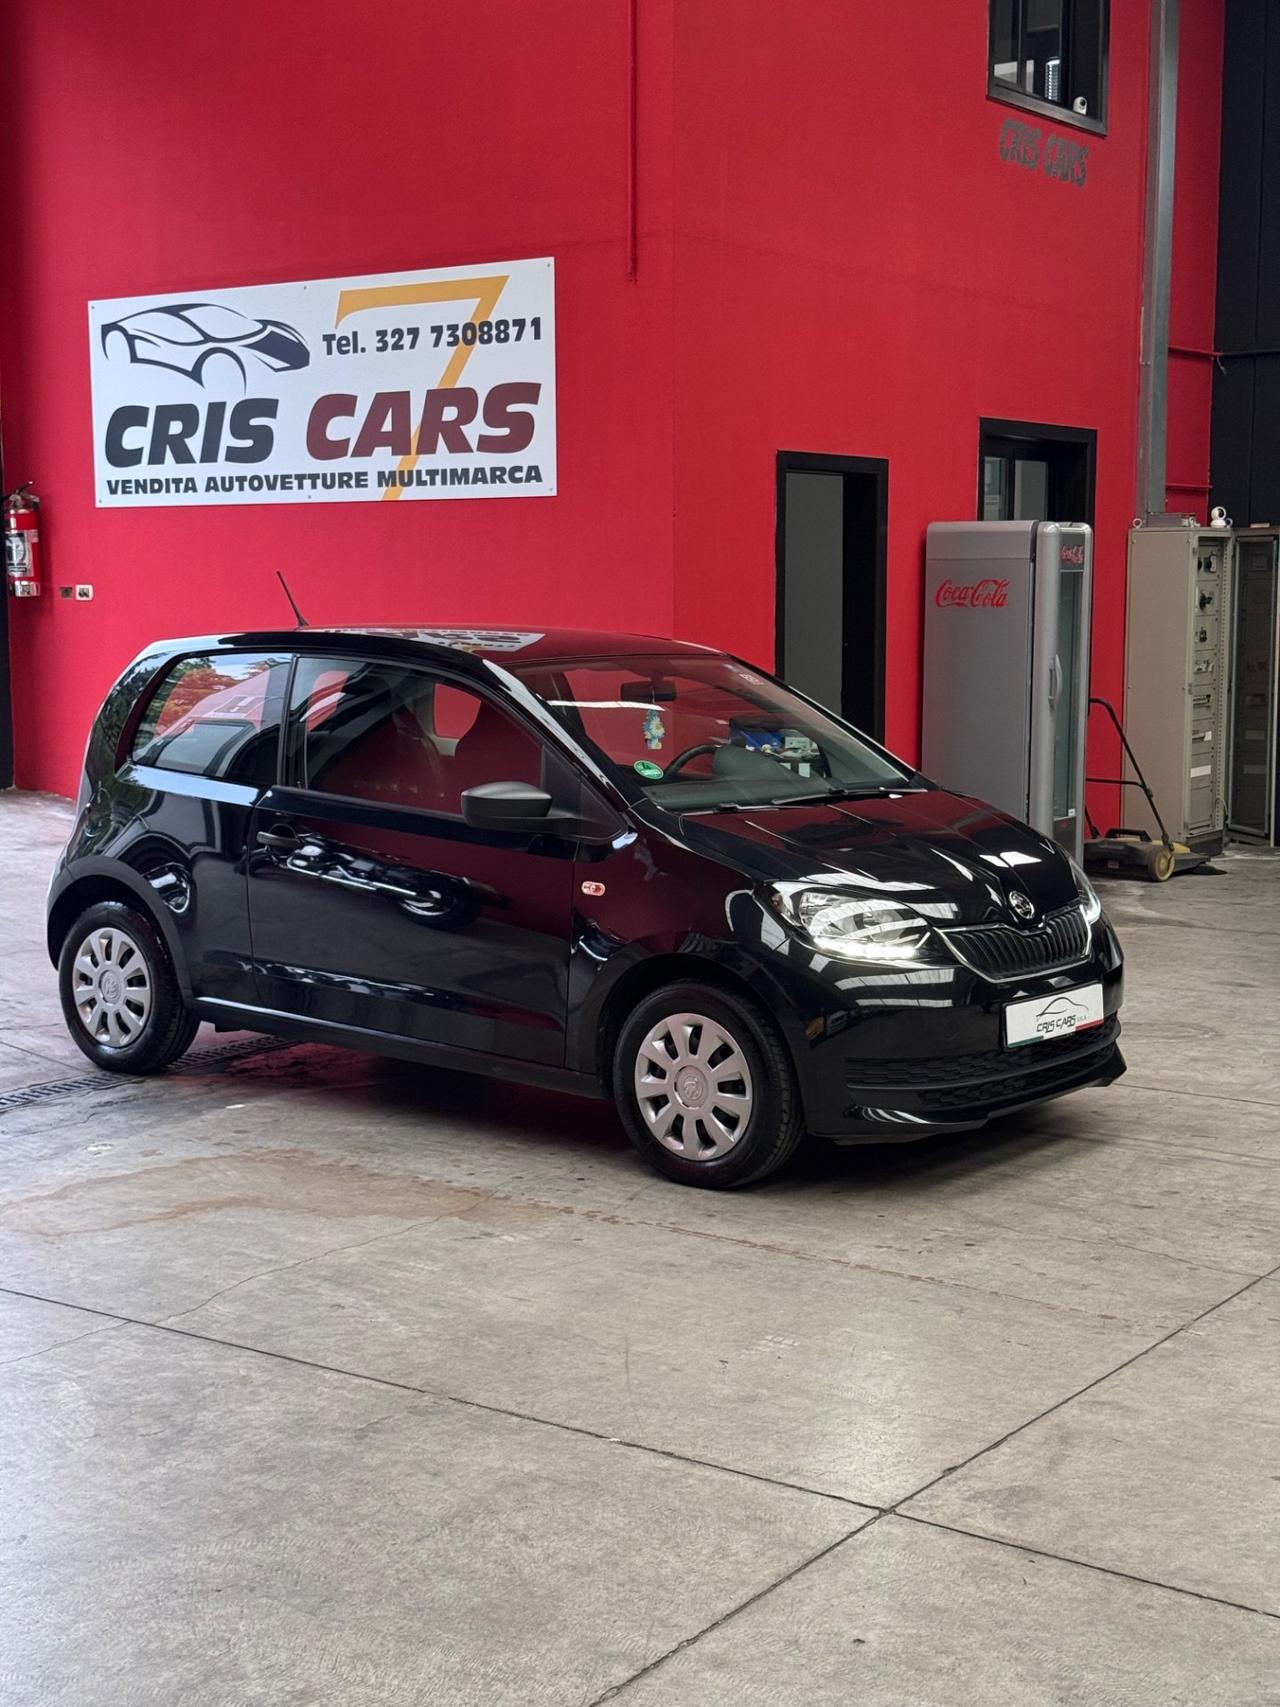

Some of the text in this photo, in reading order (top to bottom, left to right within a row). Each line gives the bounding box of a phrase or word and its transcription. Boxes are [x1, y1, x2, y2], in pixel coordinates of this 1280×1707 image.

[1044, 134, 1089, 187] CARS
[322, 317, 542, 356] Tel. 327 7308871
[105, 382, 542, 468] CRIS CARS
[106, 465, 543, 495] VENDITA AUTOVETTURE MULTIMARCA
[1036, 1020, 1055, 1033] CRIS
[1056, 1014, 1077, 1029] CARS
